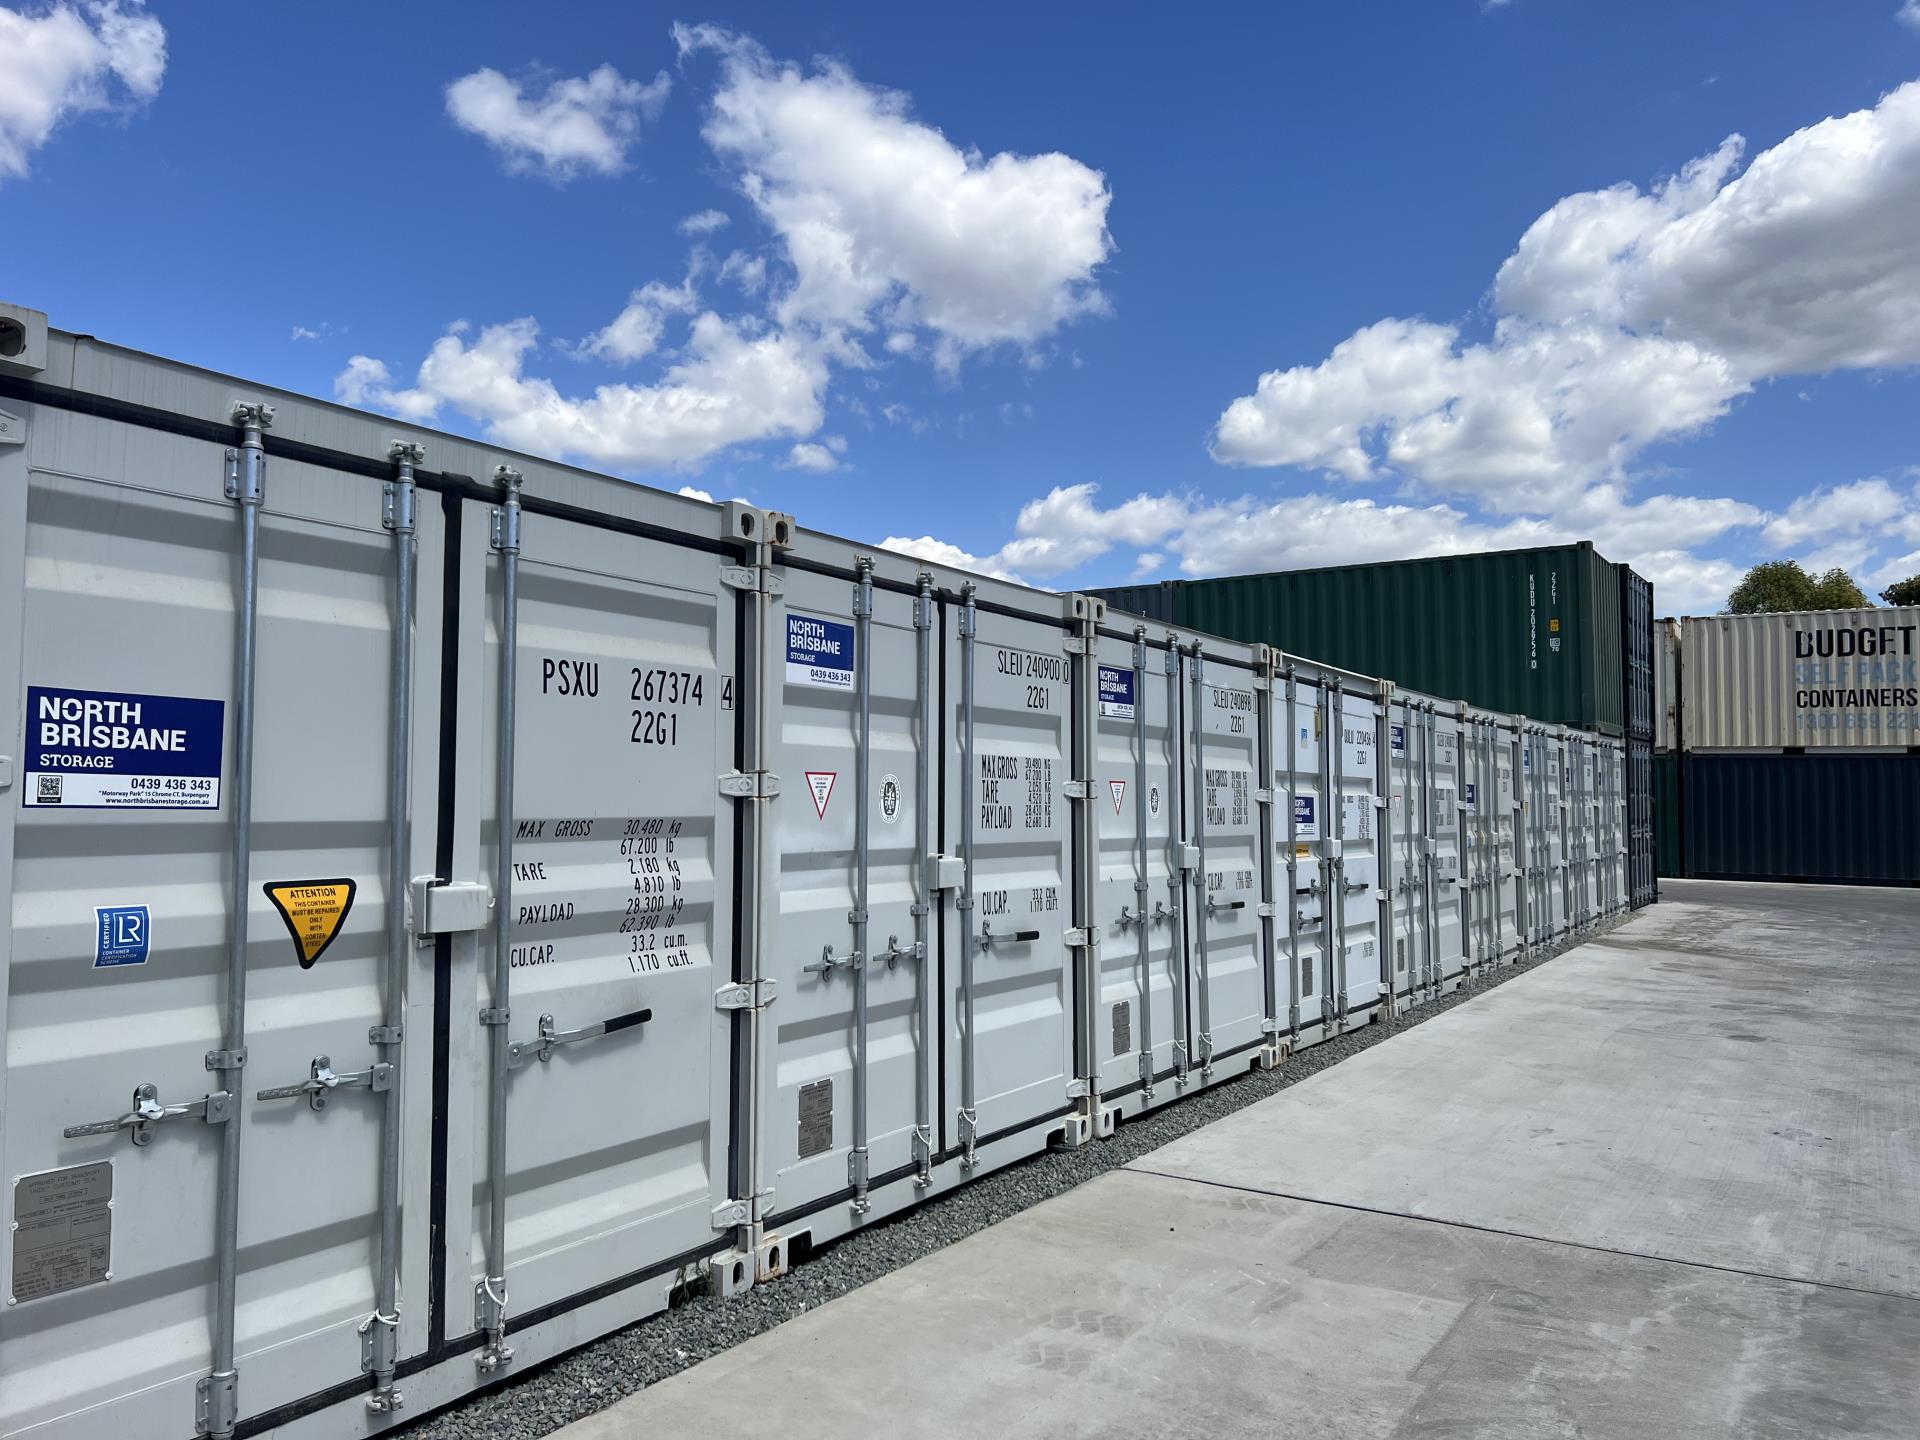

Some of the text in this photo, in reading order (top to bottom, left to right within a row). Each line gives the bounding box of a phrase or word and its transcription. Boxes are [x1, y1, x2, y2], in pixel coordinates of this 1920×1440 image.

[790, 620, 824, 638] NORTH
[790, 634, 840, 654] BRISBANE
[1795, 626, 1916, 658] BUDGET
[790, 652, 816, 662] STORAGE
[998, 650, 1022, 676] SLEU
[1026, 655, 1060, 680] 240900
[542, 658, 734, 708] PSXU 267374 4
[810, 668, 850, 682] 0439 436 343
[1100, 670, 1118, 682] NORTH
[1796, 660, 1916, 684] SELF PACK
[1027, 686, 1049, 710] 22G1
[1100, 680, 1128, 694] BRISBANE
[1796, 688, 1918, 708] CONTAINERS
[40, 696, 141, 725] NORTH
[1214, 690, 1228, 709] SLEU
[631, 710, 677, 746] 22G1
[1230, 715, 1245, 734] 22G1
[40, 722, 186, 752] BRISBANE
[40, 754, 114, 768] STORAGE
[982, 754, 996, 779] MAX
[998, 756, 1018, 780] GROSS
[131, 778, 211, 791] 0439 436 343
[982, 780, 998, 804] TARE
[516, 819, 682, 838] MAX GROSS 30.480 kg
[982, 806, 1012, 829] PAYLOAD
[620, 838, 674, 855] 67.200 lb
[513, 857, 681, 882] TARE 2.180 kg
[290, 888, 336, 899] ATTENTION
[634, 876, 681, 894] 4.810 lb
[518, 895, 684, 925] PAYLOAD 28.300 kg
[982, 890, 1010, 916] CU.CAP.
[118, 916, 141, 943] LR
[619, 914, 675, 933] 62.390 lb
[511, 933, 688, 968] CU.CAP. 33.2 cu.m.
[628, 950, 693, 973] 1.170 cu.ft.
